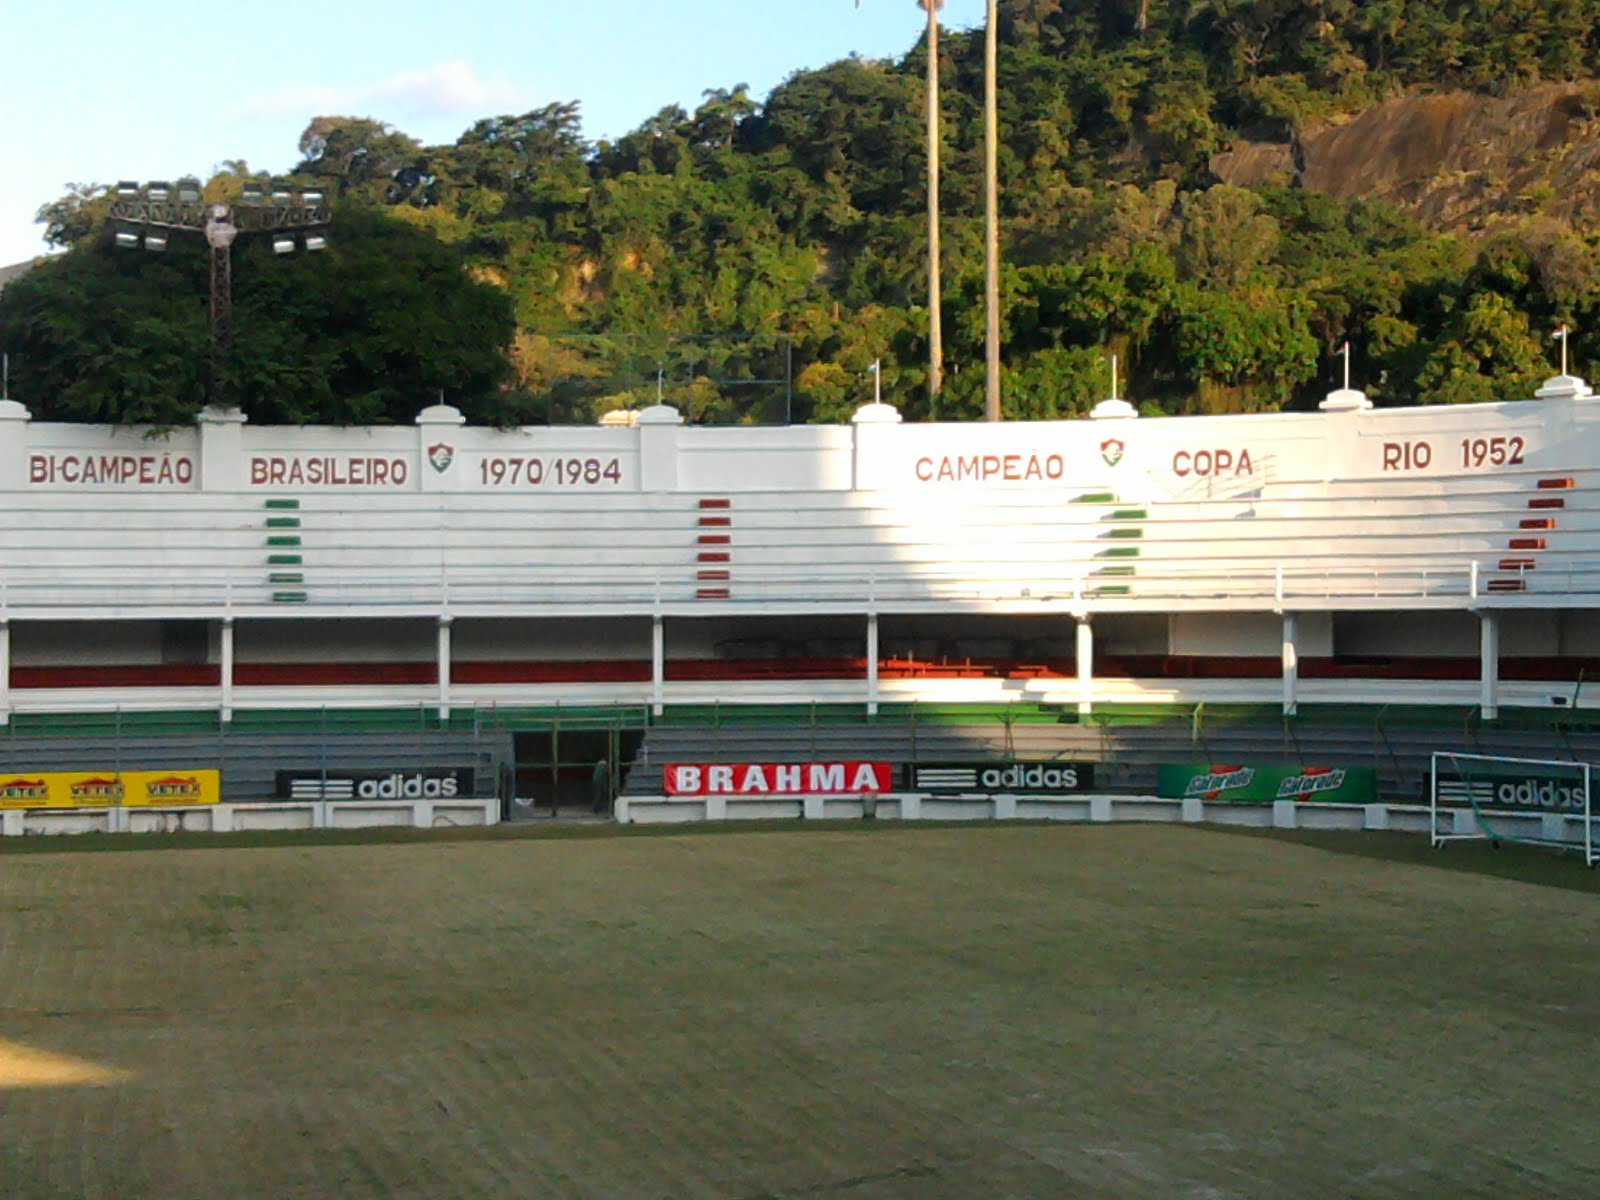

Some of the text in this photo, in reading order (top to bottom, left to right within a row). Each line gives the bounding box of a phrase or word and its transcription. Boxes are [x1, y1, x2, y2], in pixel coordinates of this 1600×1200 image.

[29, 453, 622, 485] BI-CAMPEÃO BRASILEIRO 1970/1984
[1173, 449, 1253, 477] COPA
[1383, 441, 1432, 470] RIO
[1462, 436, 1524, 467] 1952
[358, 774, 458, 798] adidas
[676, 763, 880, 792] BRAHMA
[981, 764, 1078, 789] adidas
[1498, 779, 1586, 807] adidas
